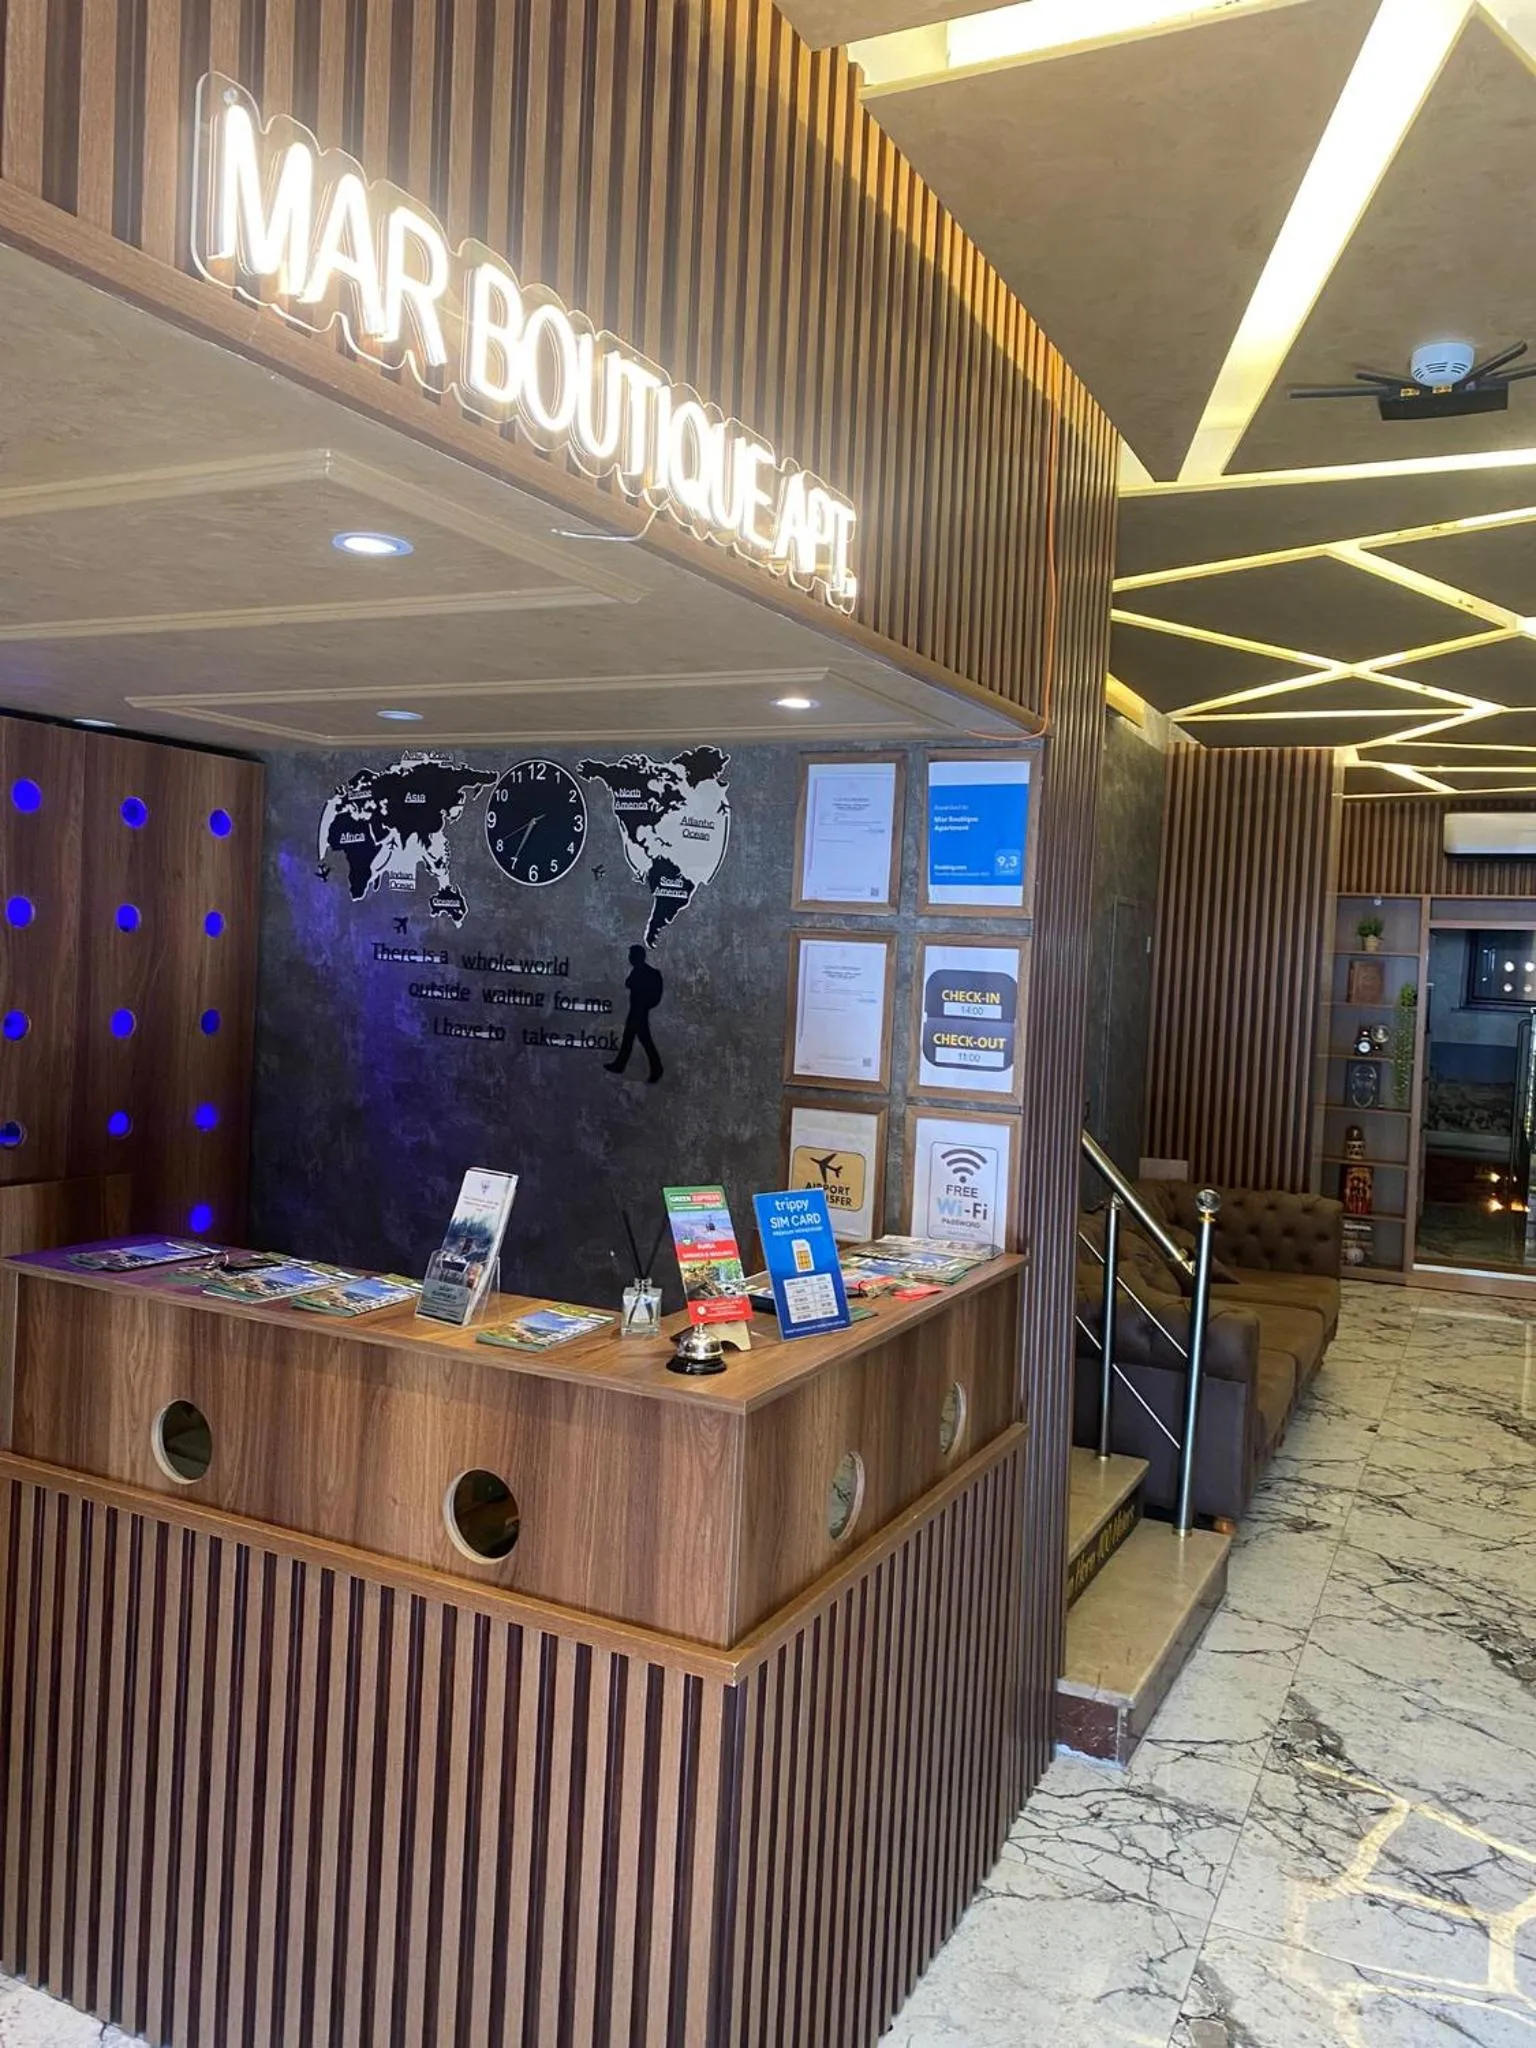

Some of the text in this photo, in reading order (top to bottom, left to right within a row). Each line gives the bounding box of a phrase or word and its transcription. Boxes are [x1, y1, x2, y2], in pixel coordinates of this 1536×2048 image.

[205, 103, 858, 598] MAR BOUTIQUE APT.
[510, 771, 522, 783] 11
[528, 763, 546, 780] 12
[555, 771, 561, 784] 1
[405, 792, 426, 802] Asia
[495, 789, 508, 802] 10
[569, 790, 577, 803] 2
[614, 788, 641, 798] North
[615, 801, 648, 810] America
[487, 811, 497, 828] 9
[574, 815, 583, 832] 3
[681, 816, 715, 829] Atlantic
[340, 831, 365, 843] Africa
[683, 828, 710, 841] Ocean
[496, 839, 504, 852] 8
[566, 841, 575, 854] 4
[510, 856, 518, 869] 7
[550, 860, 558, 872] 5
[528, 864, 539, 881] 6
[653, 886, 688, 898] America
[371, 943, 569, 976] There is a whole world
[409, 982, 612, 1013] outside waiting for me
[942, 989, 1000, 1004] CHECK-IN
[961, 1006, 983, 1015] 14:00
[434, 1016, 620, 1050] I have to take a look
[933, 1033, 1006, 1049] CHECK-OUT
[958, 1052, 980, 1062] 11:00
[946, 1184, 978, 1198] FREE
[775, 1197, 809, 1213] trippy
[937, 1196, 988, 1220] Wi-Fi
[770, 1213, 821, 1229] SIM CARD
[941, 1217, 981, 1229] PASSWORD
